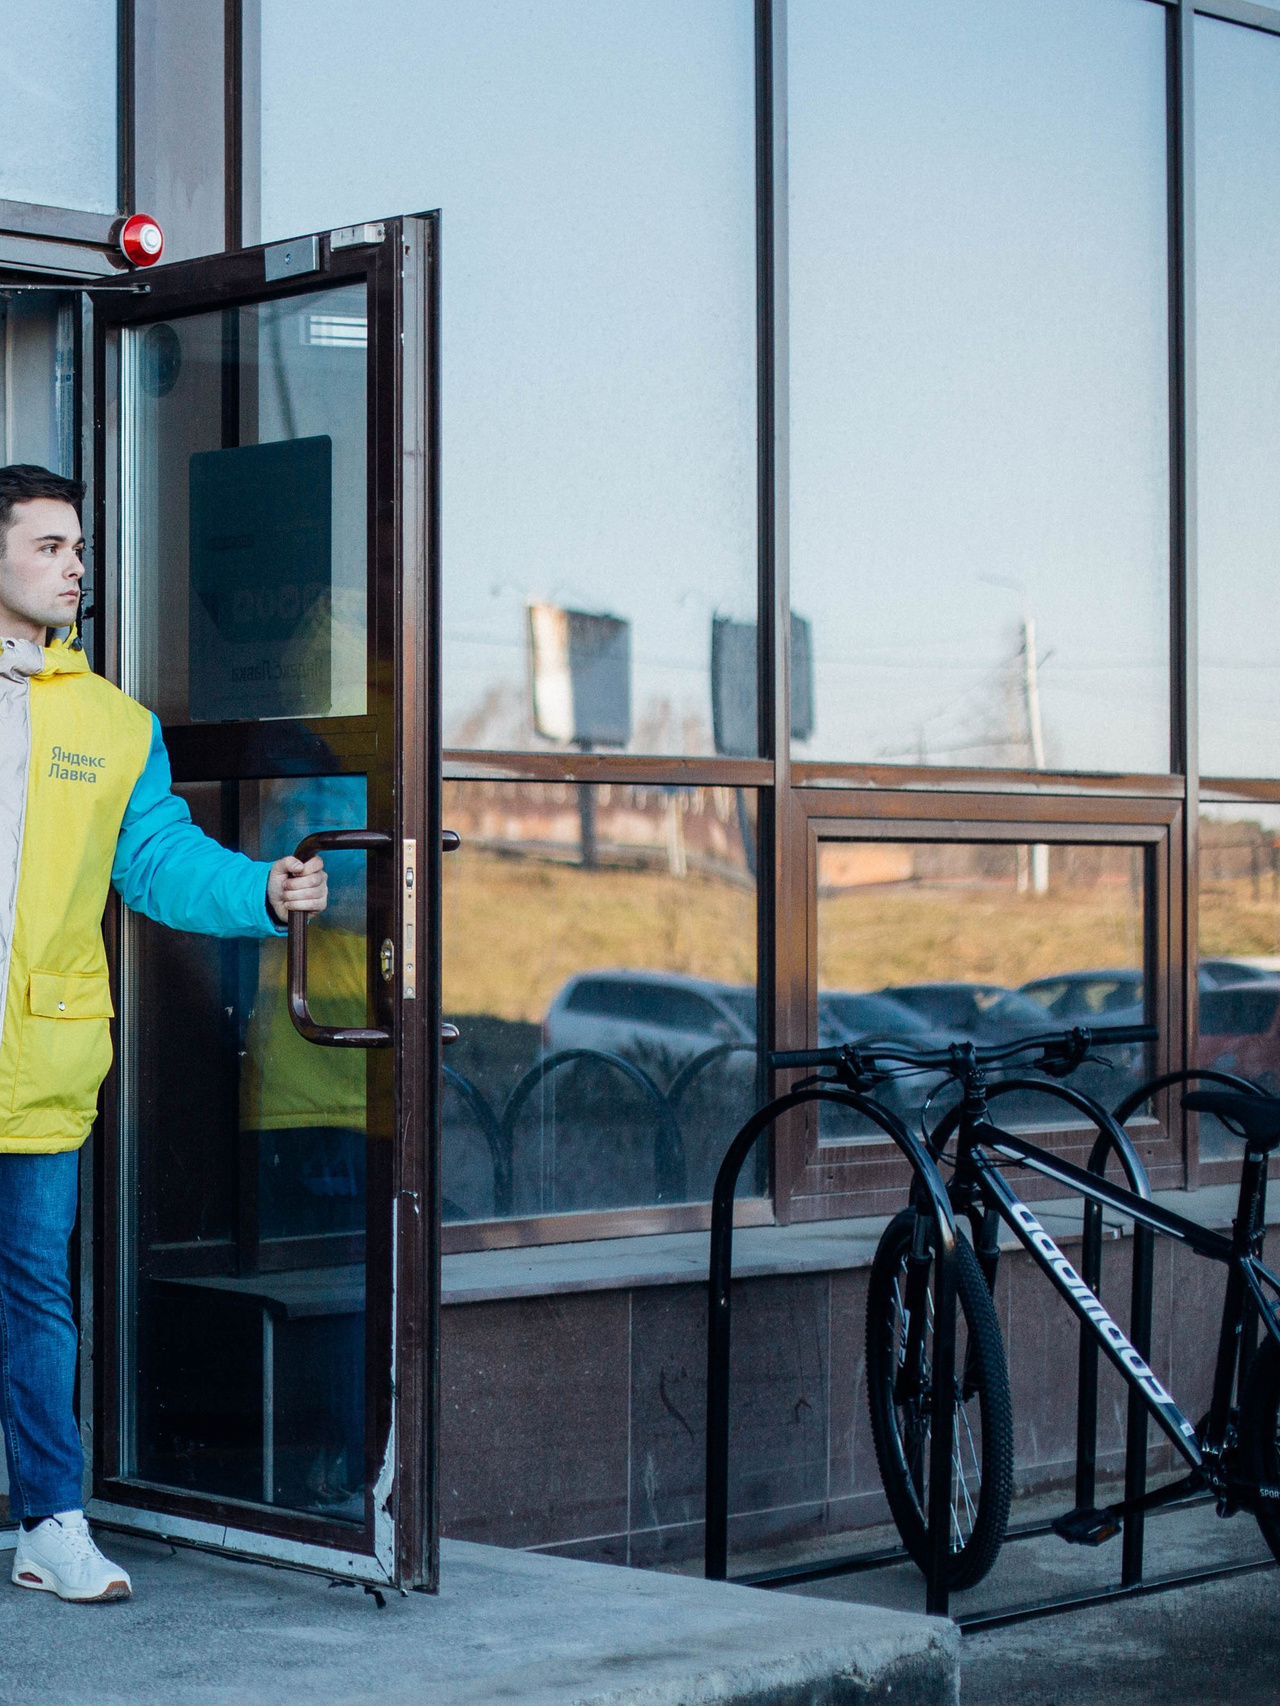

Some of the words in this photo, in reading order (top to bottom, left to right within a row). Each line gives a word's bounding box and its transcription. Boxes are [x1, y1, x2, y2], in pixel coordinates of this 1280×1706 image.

[51, 746, 106, 768] Яндекс
[48, 763, 97, 783] Лавка
[1259, 1488, 1280, 1499] SPOR
